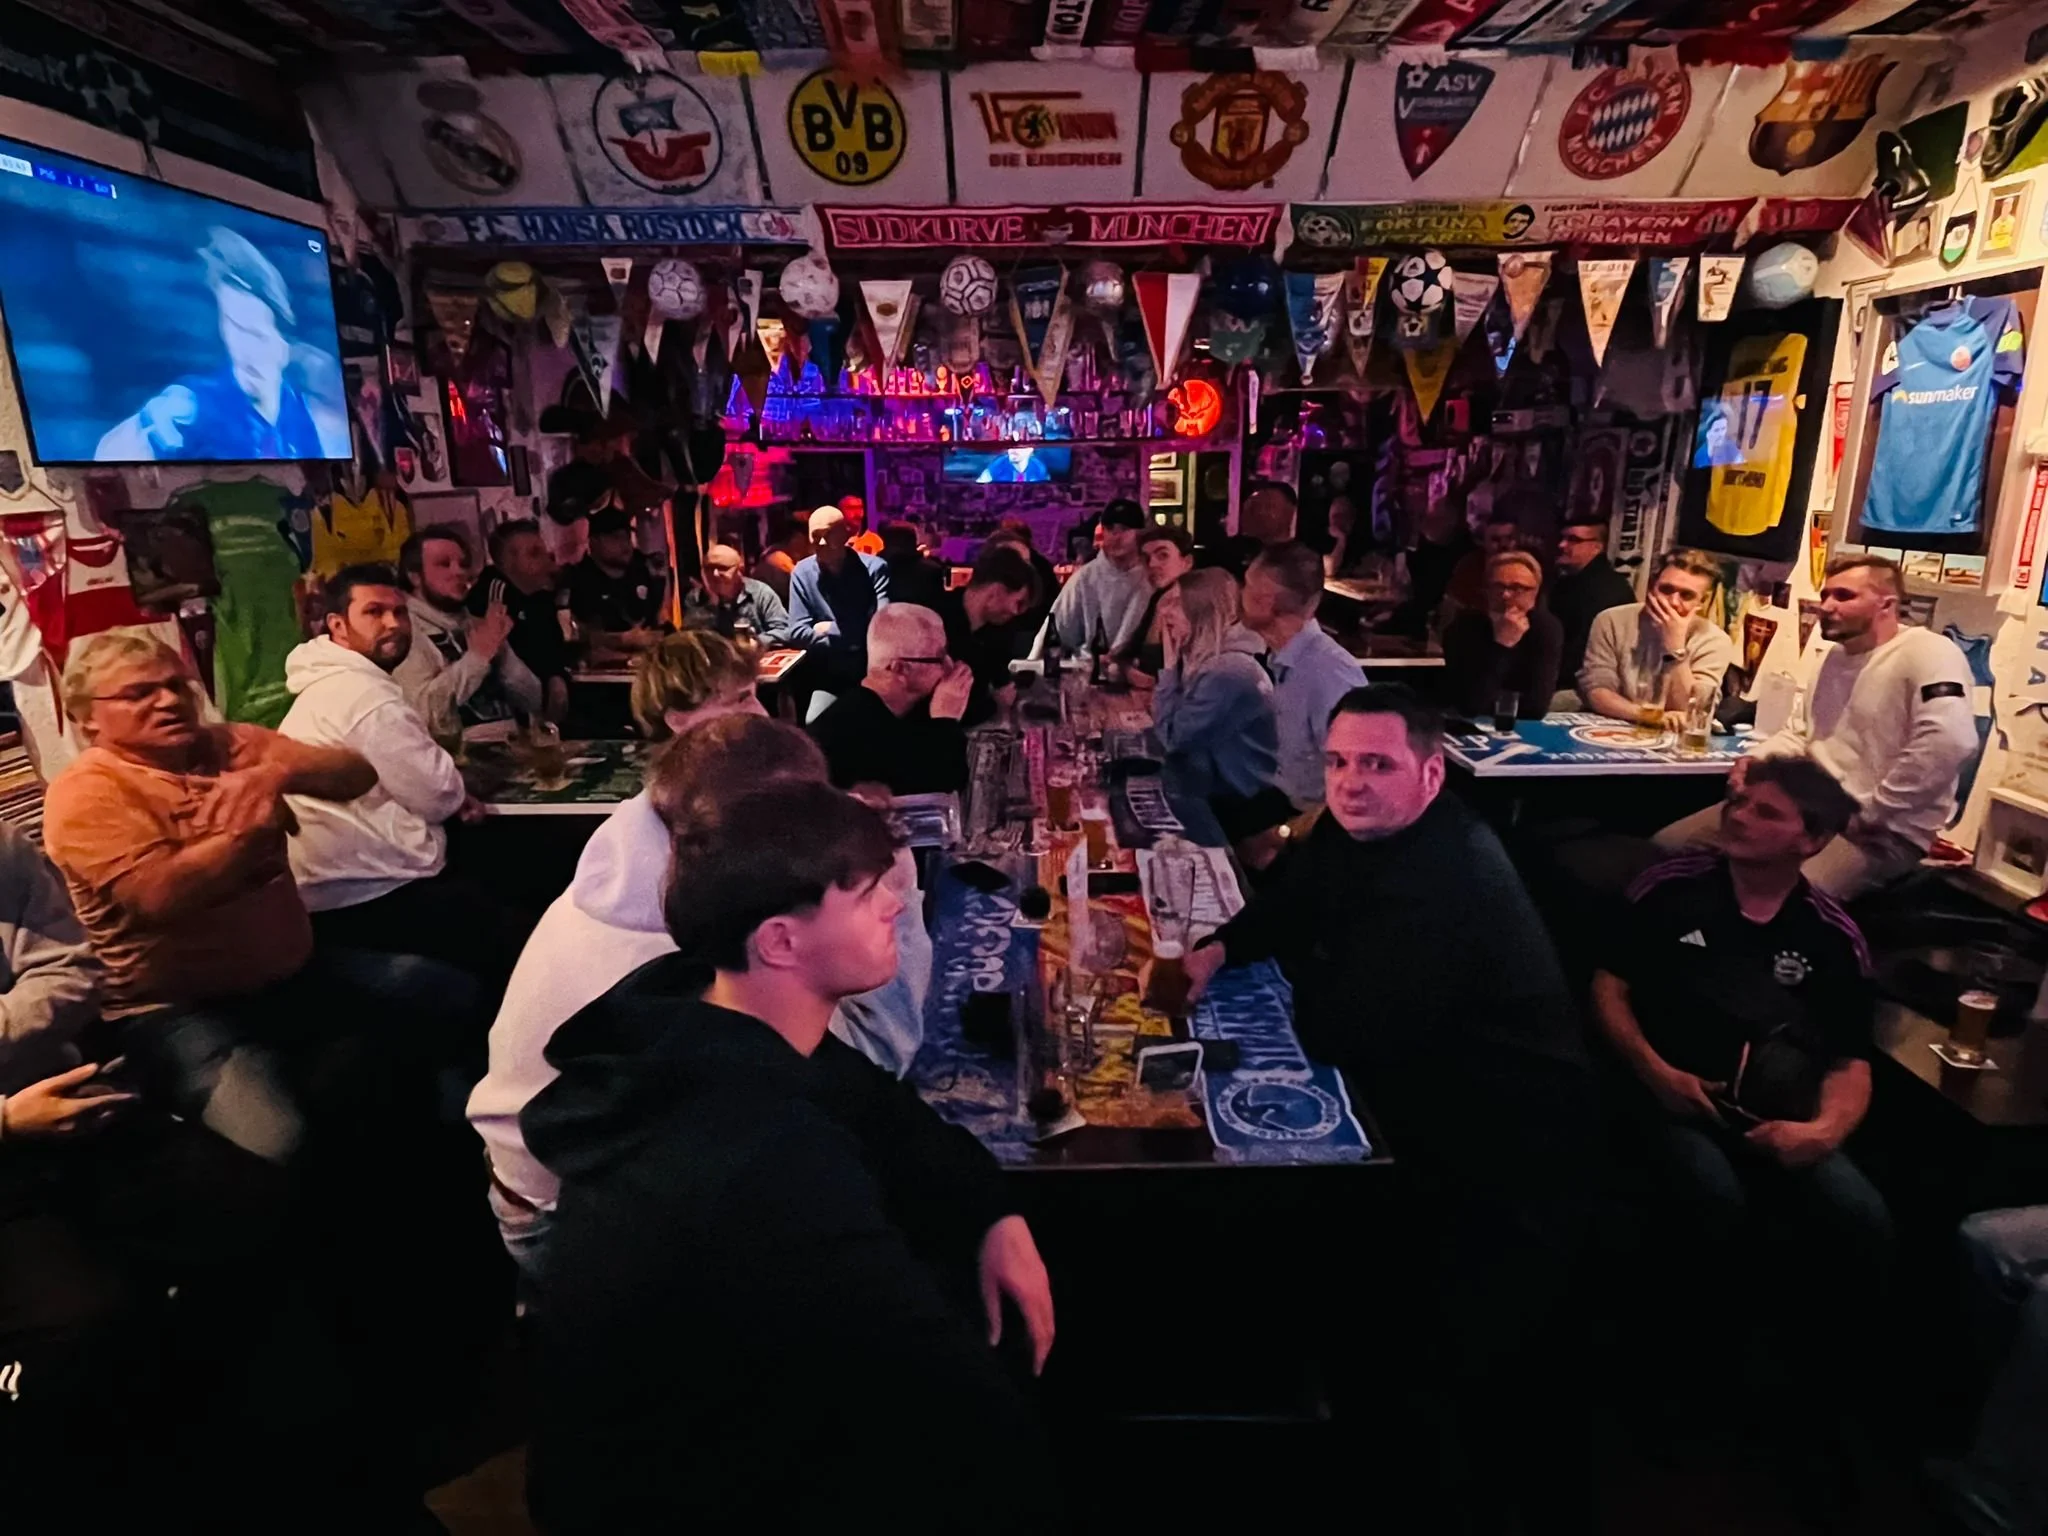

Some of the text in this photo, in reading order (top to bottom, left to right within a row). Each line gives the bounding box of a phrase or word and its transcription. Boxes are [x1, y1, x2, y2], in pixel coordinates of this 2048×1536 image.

[1434, 74, 1483, 93] ASV
[802, 78, 895, 152] BVB
[836, 151, 869, 175] 09
[989, 153, 1021, 167] DIE
[620, 213, 749, 240] ROSTOCK
[1359, 214, 1488, 231] FORTUNA
[1588, 214, 1690, 230] BAYERN
[1908, 384, 1979, 405] sunmaker
